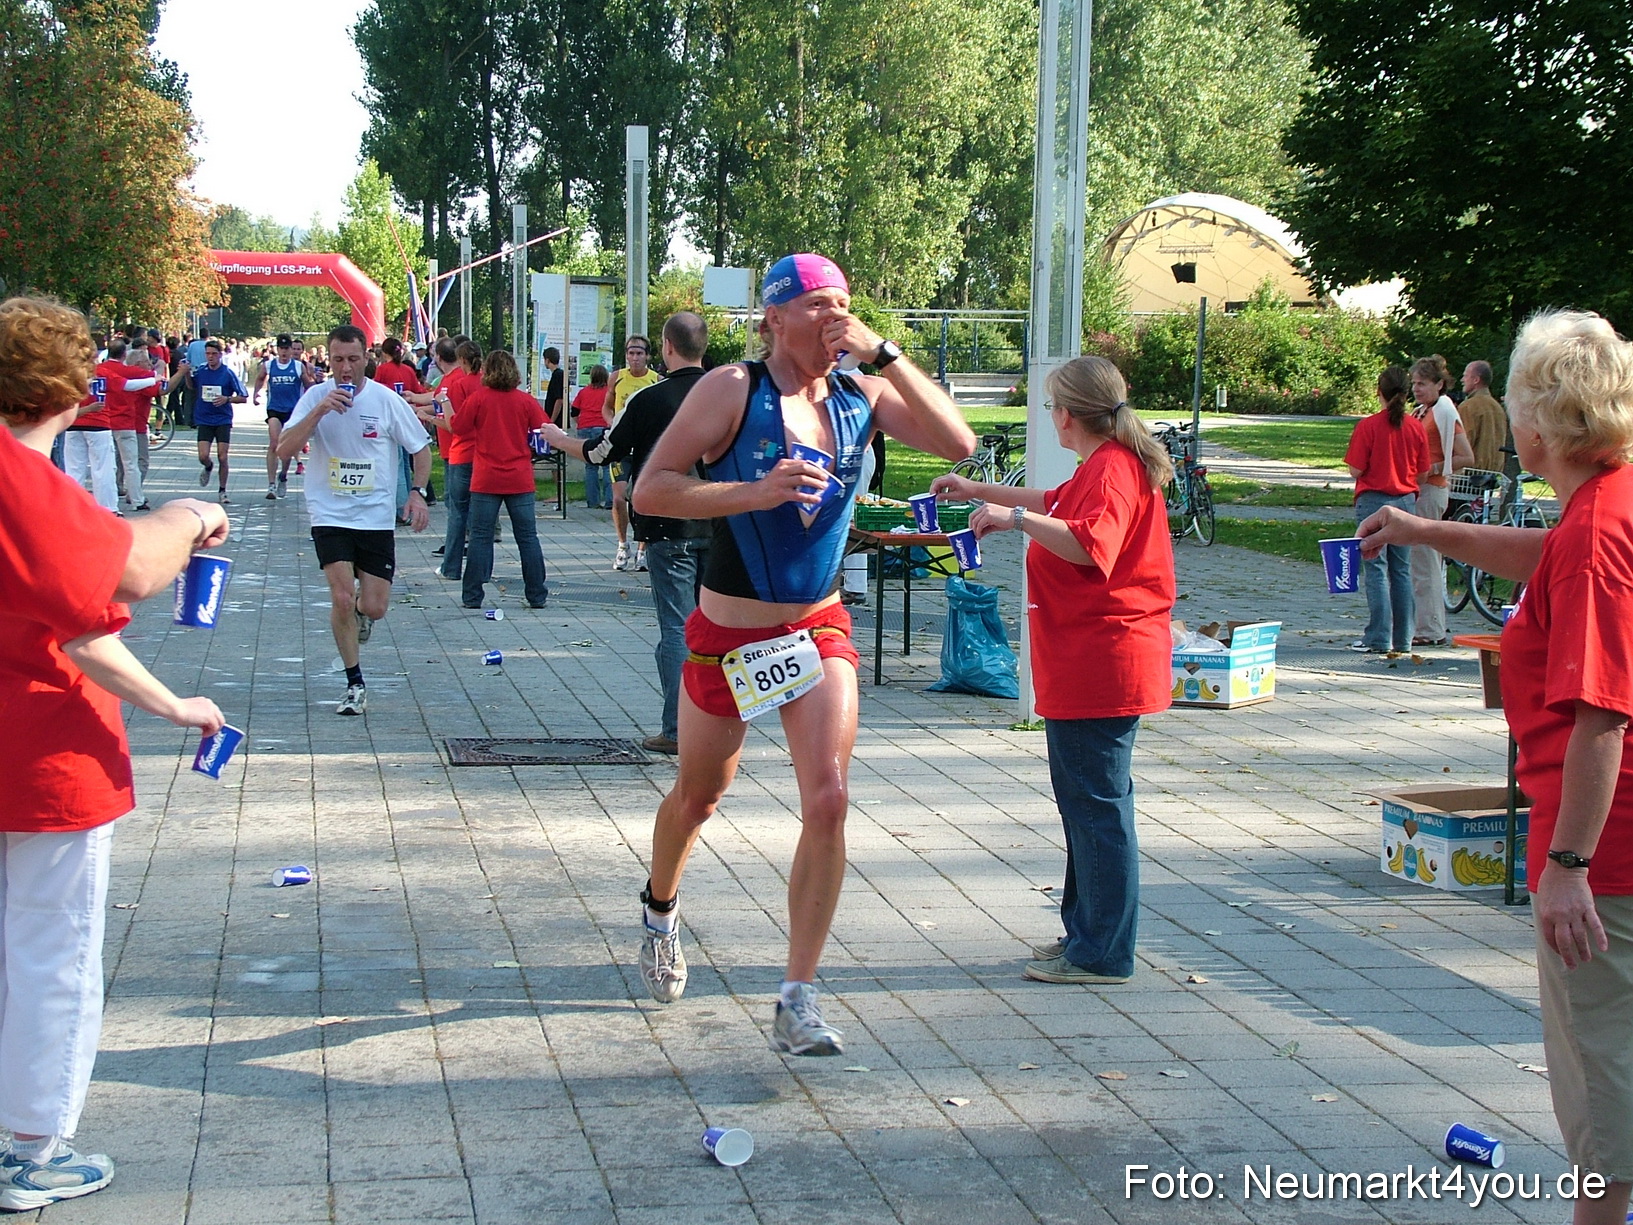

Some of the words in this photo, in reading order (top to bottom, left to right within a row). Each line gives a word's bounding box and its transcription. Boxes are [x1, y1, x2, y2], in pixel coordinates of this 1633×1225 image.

[209, 262, 271, 275] Verpflegung
[273, 265, 322, 274] LGS-Park
[340, 462, 371, 470] Wolfgang
[340, 474, 364, 486] 457
[1335, 545, 1350, 590] Xenofit
[197, 565, 225, 624] Xenofit
[1171, 654, 1190, 662] MIUM
[1194, 656, 1226, 664] BANANAS
[755, 656, 801, 691] 805
[735, 676, 746, 689] A
[1384, 803, 1410, 819] PREMIUM
[1463, 820, 1519, 833] PREMIU
